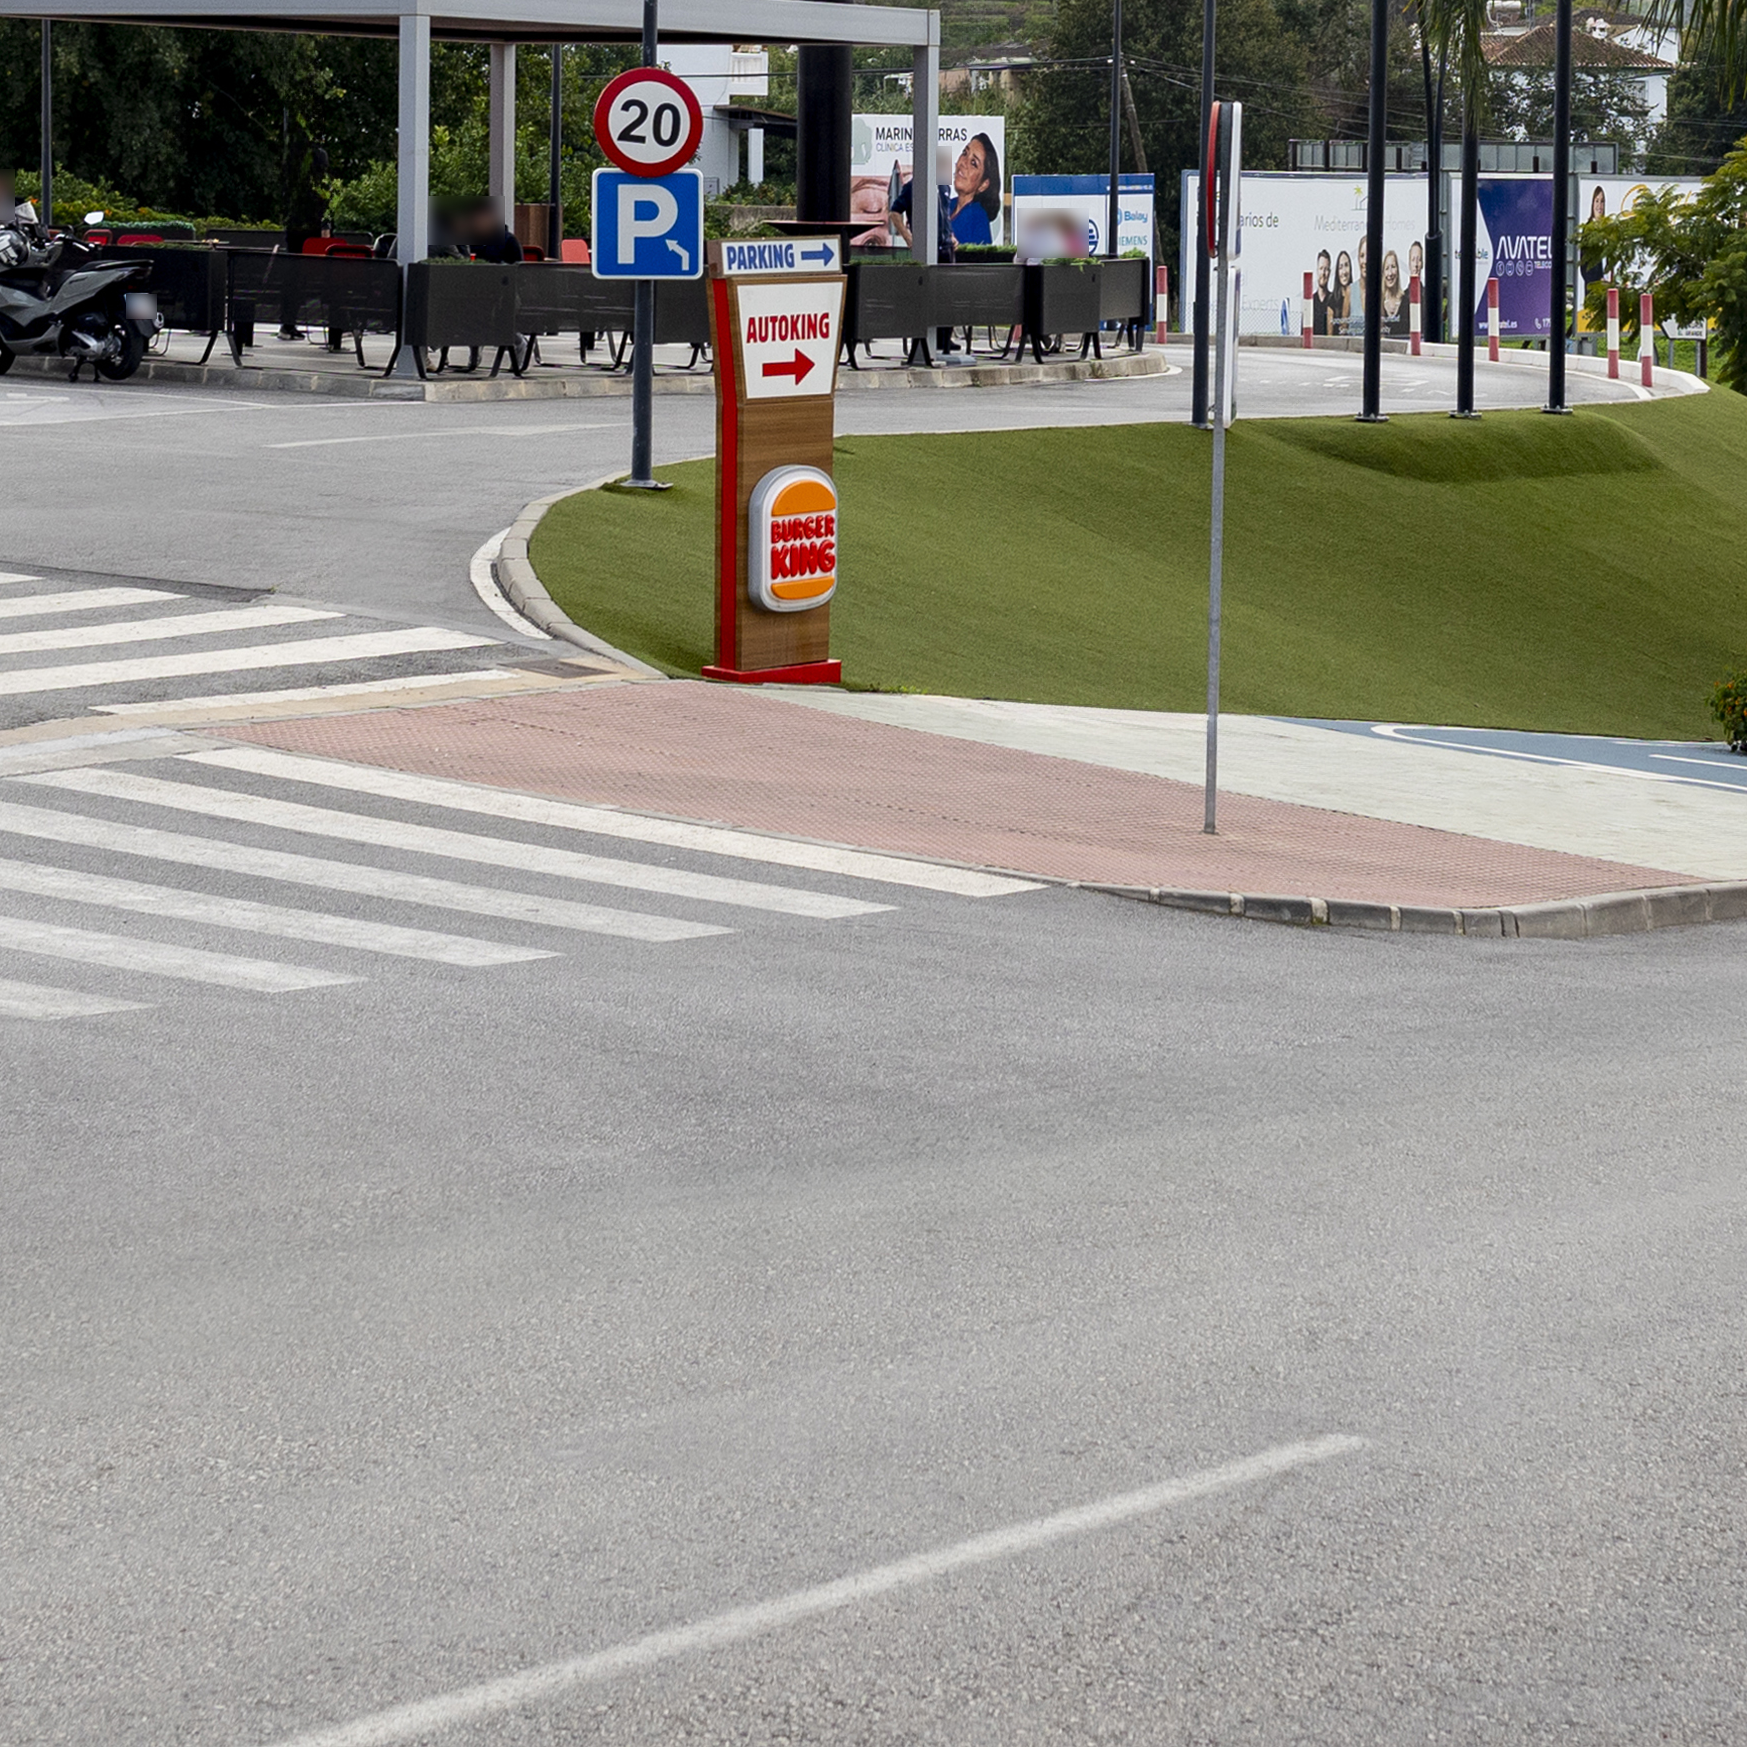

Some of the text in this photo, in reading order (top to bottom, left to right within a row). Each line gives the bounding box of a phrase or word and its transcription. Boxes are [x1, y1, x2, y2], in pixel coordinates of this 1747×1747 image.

[617, 99, 682, 148] 20
[617, 182, 679, 265] P
[1266, 212, 1279, 228] de
[1119, 235, 1148, 246] IEMENS
[727, 245, 795, 271] PARKING
[746, 312, 830, 344] AUTOKING
[771, 515, 835, 544] BURGER
[771, 539, 836, 580] KING
